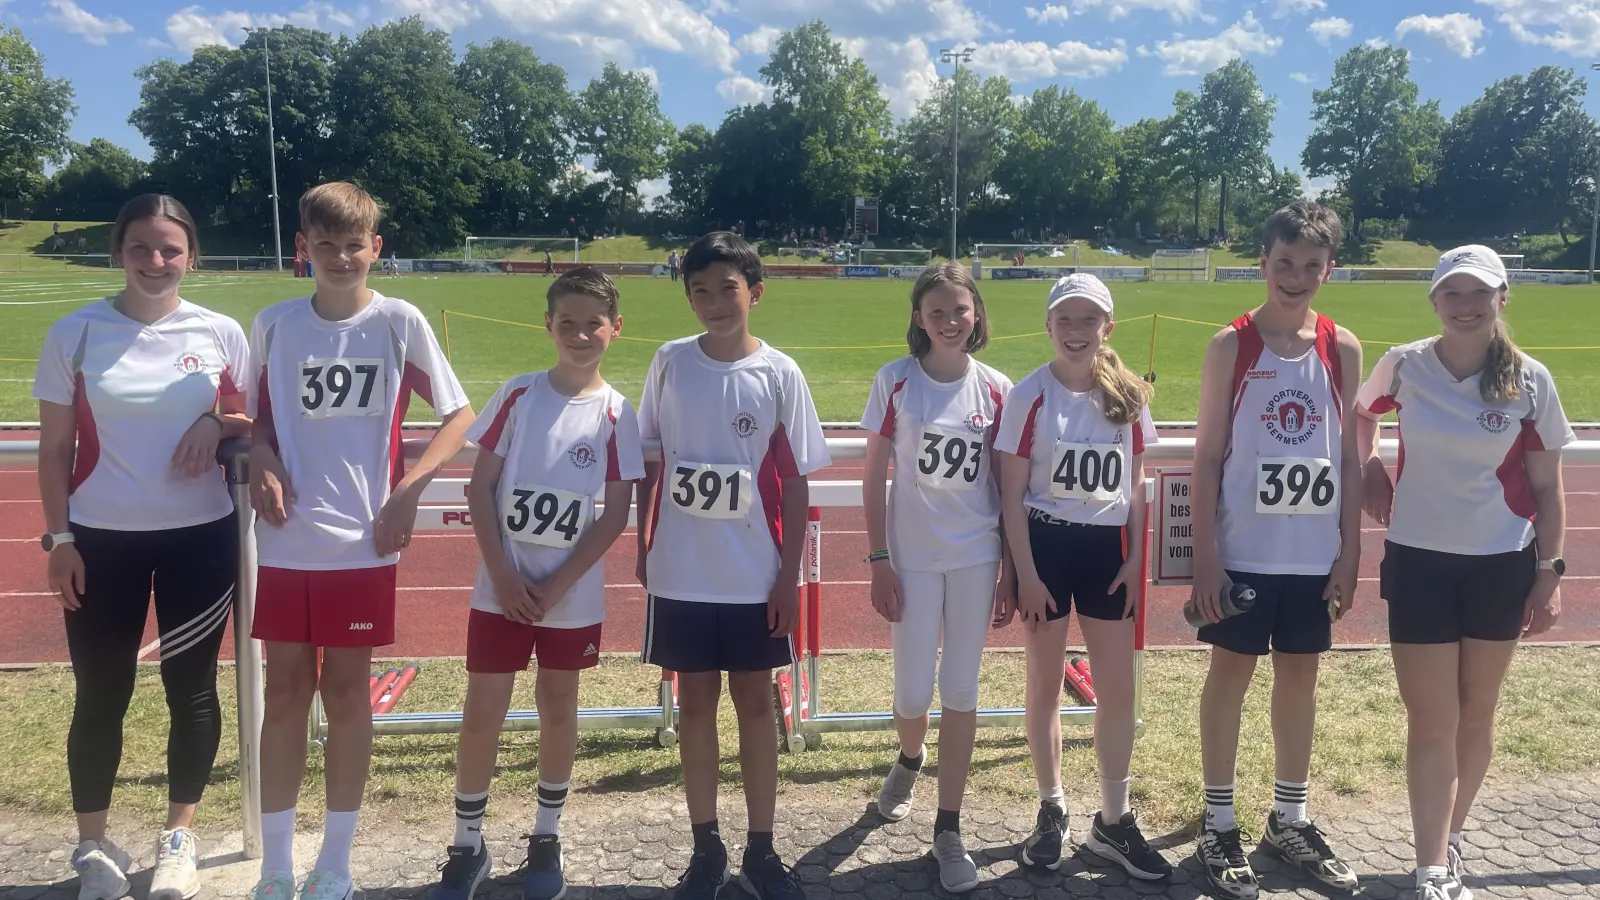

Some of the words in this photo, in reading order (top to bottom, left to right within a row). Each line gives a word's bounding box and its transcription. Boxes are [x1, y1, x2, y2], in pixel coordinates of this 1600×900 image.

[302, 365, 378, 410] 397
[1266, 389, 1316, 415] SPORTVEREIN
[1266, 421, 1316, 445] GERMERING
[918, 432, 983, 483] 393
[1053, 450, 1121, 492] 400
[673, 466, 740, 511] 391
[1260, 464, 1334, 506] 396
[507, 489, 581, 541] 394
[810, 535, 818, 568] polanik
[1169, 546, 1193, 558] vom
[348, 622, 374, 630] JAKO
